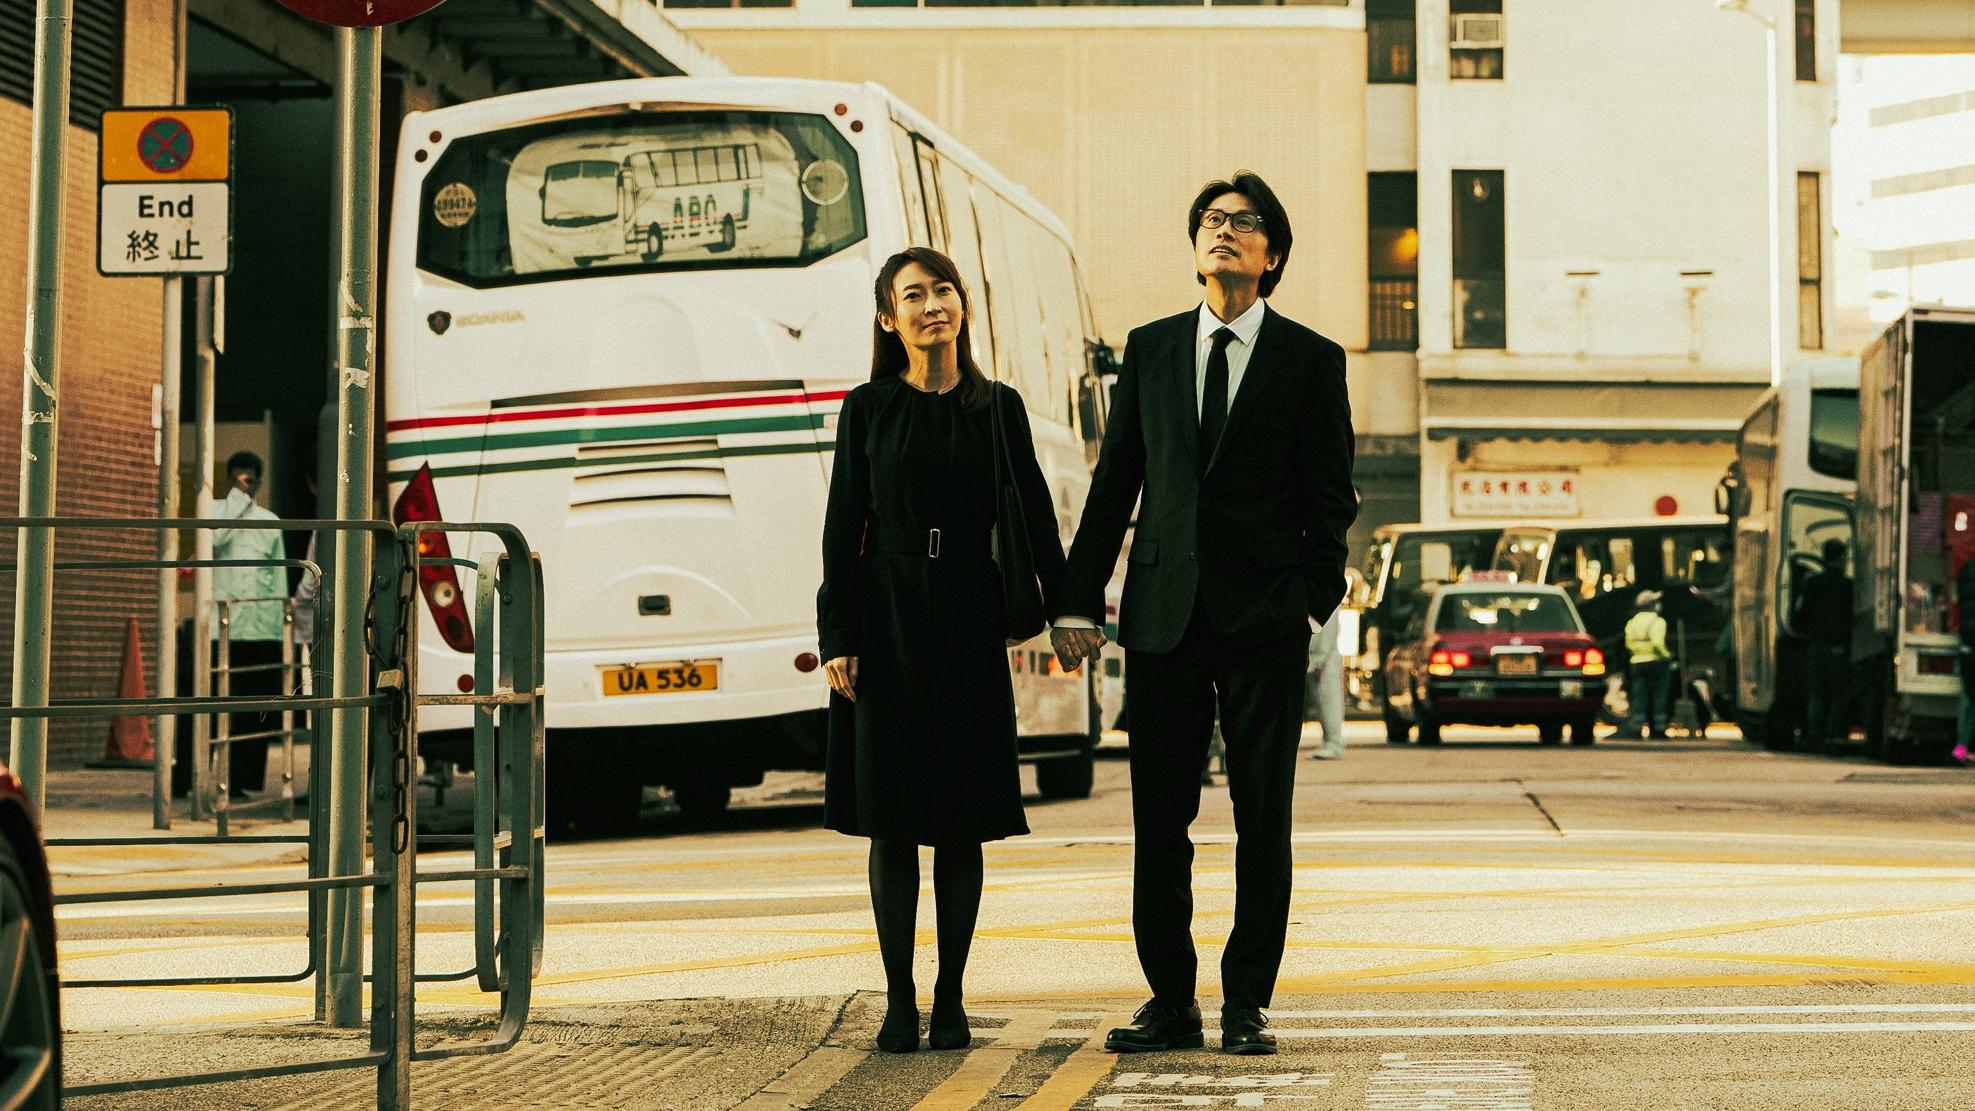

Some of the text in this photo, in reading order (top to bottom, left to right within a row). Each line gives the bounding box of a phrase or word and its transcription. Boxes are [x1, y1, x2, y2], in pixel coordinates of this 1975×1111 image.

[138, 194, 194, 218] End
[126, 229, 204, 263] 終止
[617, 667, 703, 692] UA 536
